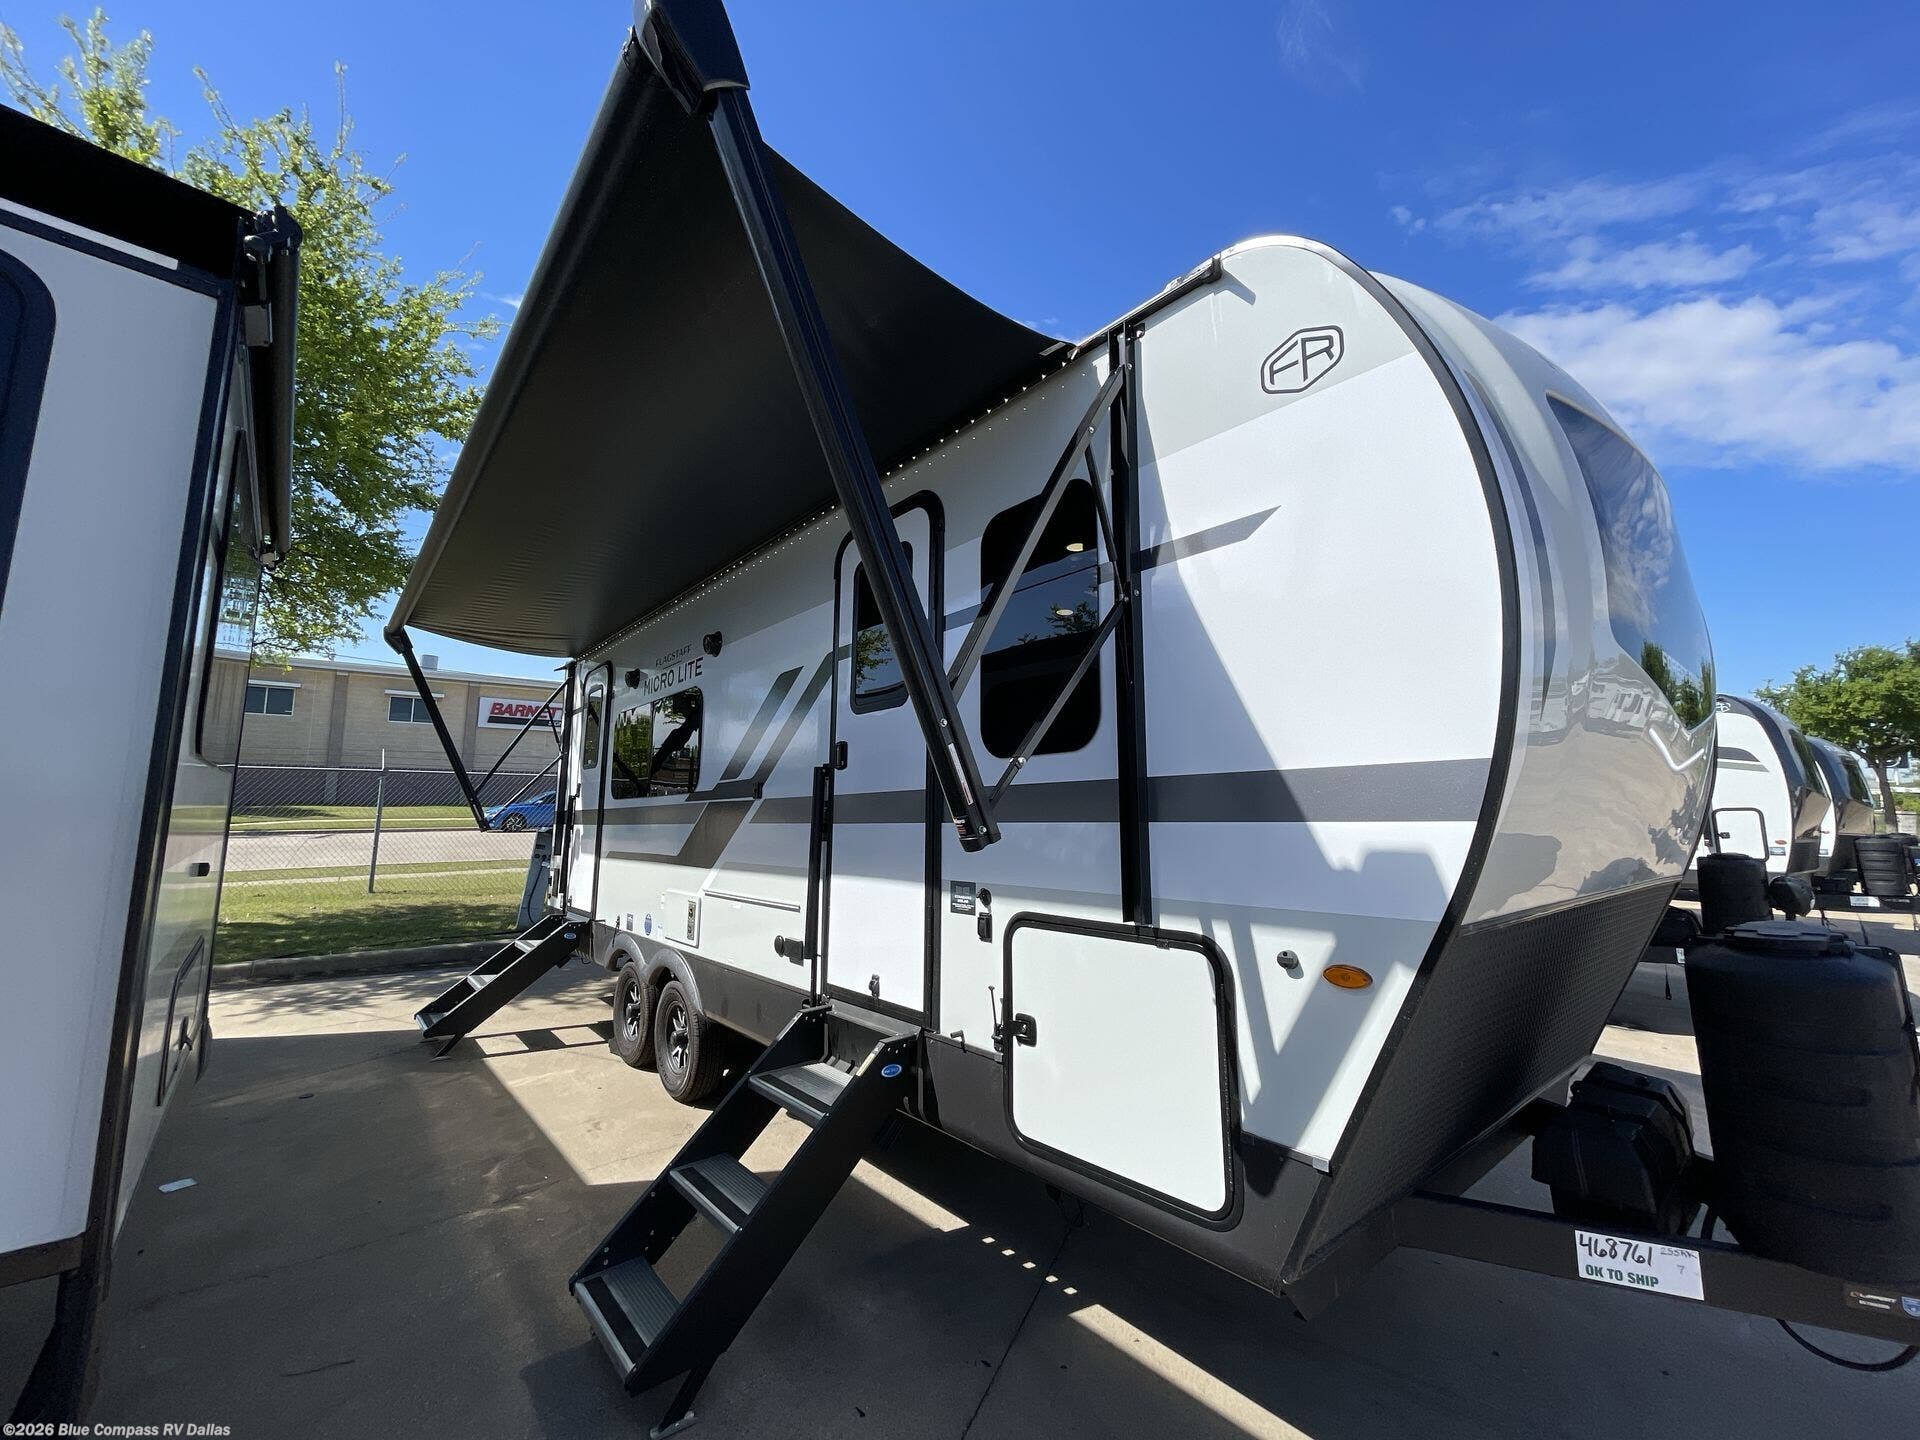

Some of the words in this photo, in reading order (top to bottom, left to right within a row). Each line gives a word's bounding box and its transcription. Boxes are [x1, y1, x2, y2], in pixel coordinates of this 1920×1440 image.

[655, 643, 692, 668] FLAGSTAFF
[643, 669, 675, 696] MICRO
[678, 656, 704, 684] LITE
[490, 701, 563, 719] BARNET
[1579, 1233, 1653, 1267] 468761
[1585, 1264, 1604, 1278] OK
[1606, 1268, 1623, 1281] TO
[1627, 1272, 1659, 1288] SHIP
